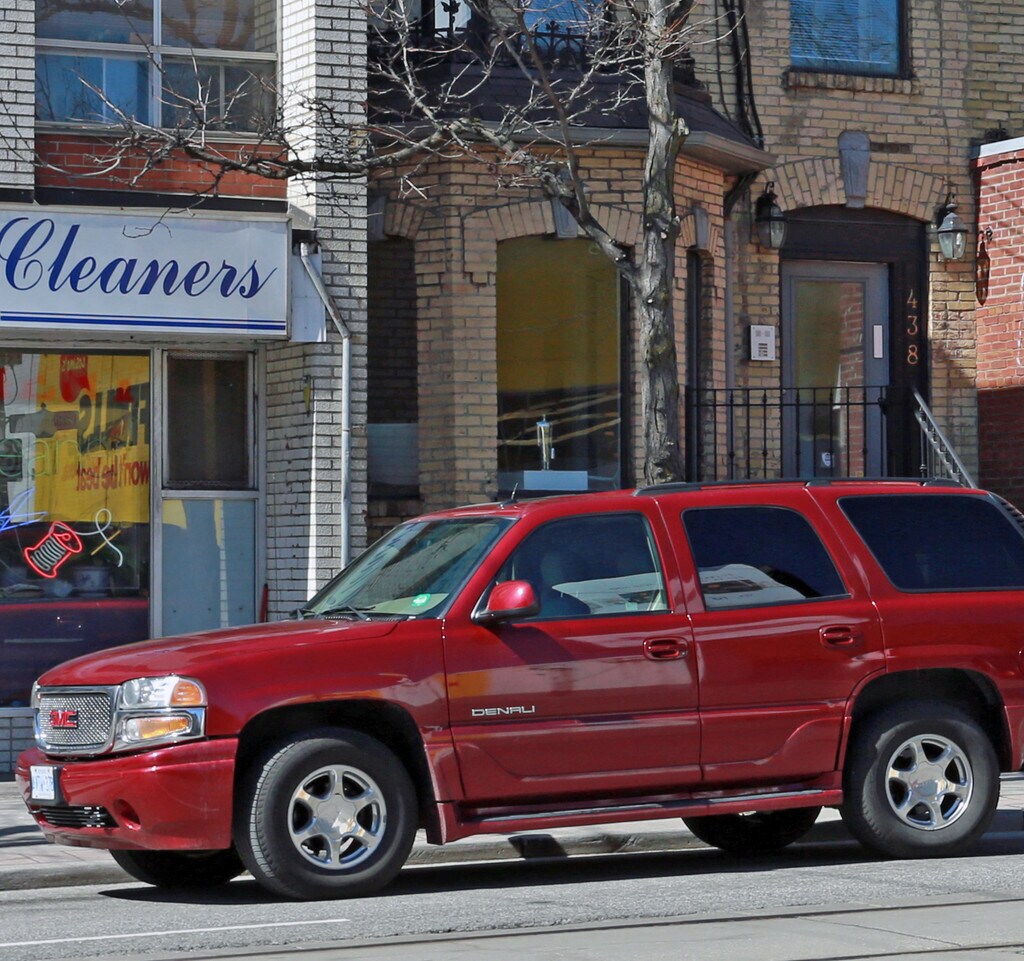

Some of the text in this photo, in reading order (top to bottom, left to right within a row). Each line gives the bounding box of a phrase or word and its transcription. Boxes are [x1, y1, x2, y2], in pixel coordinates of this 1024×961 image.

[0, 216, 278, 300] Cleaners
[906, 289, 919, 365] 438
[50, 709, 78, 727] GMC
[471, 705, 536, 717] DENALI
